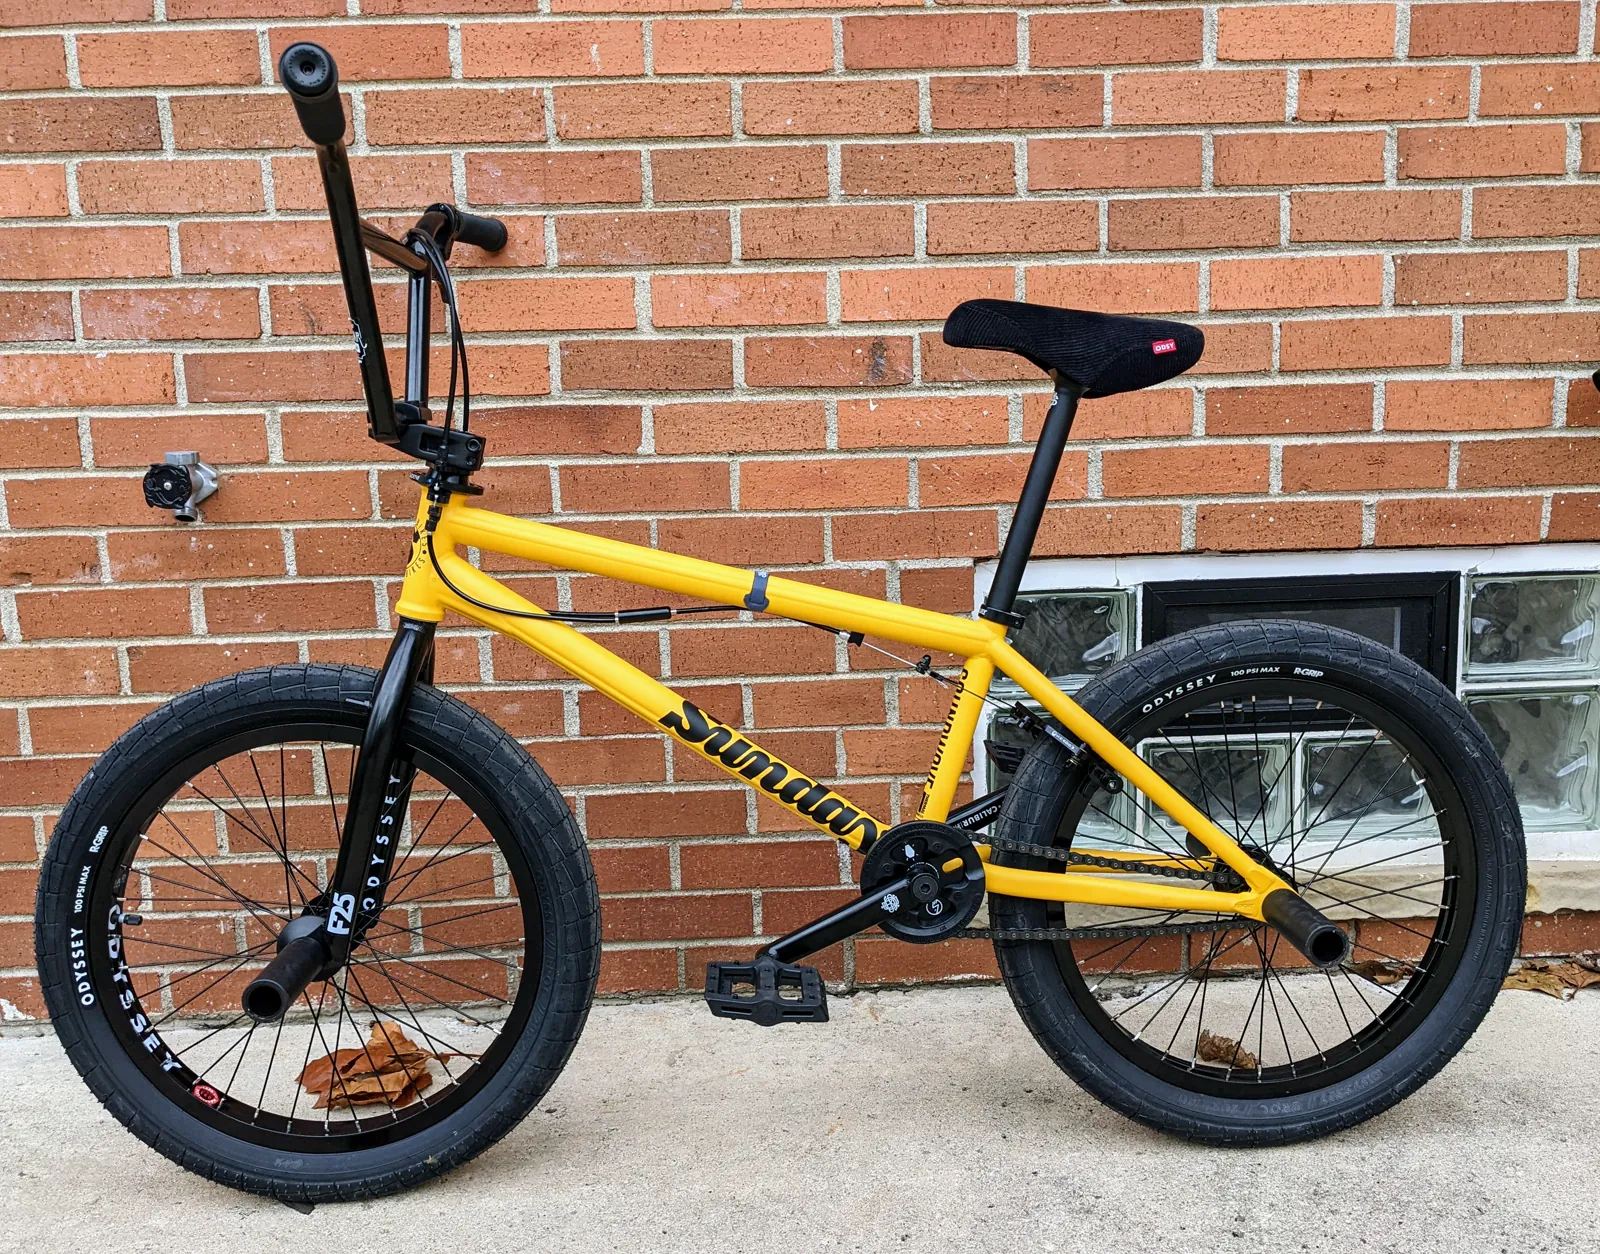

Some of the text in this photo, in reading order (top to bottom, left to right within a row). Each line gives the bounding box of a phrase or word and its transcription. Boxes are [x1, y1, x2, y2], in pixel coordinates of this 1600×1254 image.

[1155, 342, 1174, 352] ODSY
[1142, 674, 1217, 713] ODYSSEY
[1230, 669, 1244, 677] 100
[1260, 666, 1281, 674] MAX
[363, 774, 401, 912] ODYSSEY
[76, 885, 86, 898] PSI
[79, 865, 92, 885] MAX
[74, 899, 84, 914] 100
[326, 891, 356, 935] F25
[71, 928, 95, 1006] ODYSSEY
[108, 904, 183, 1072] ODYSSEY
